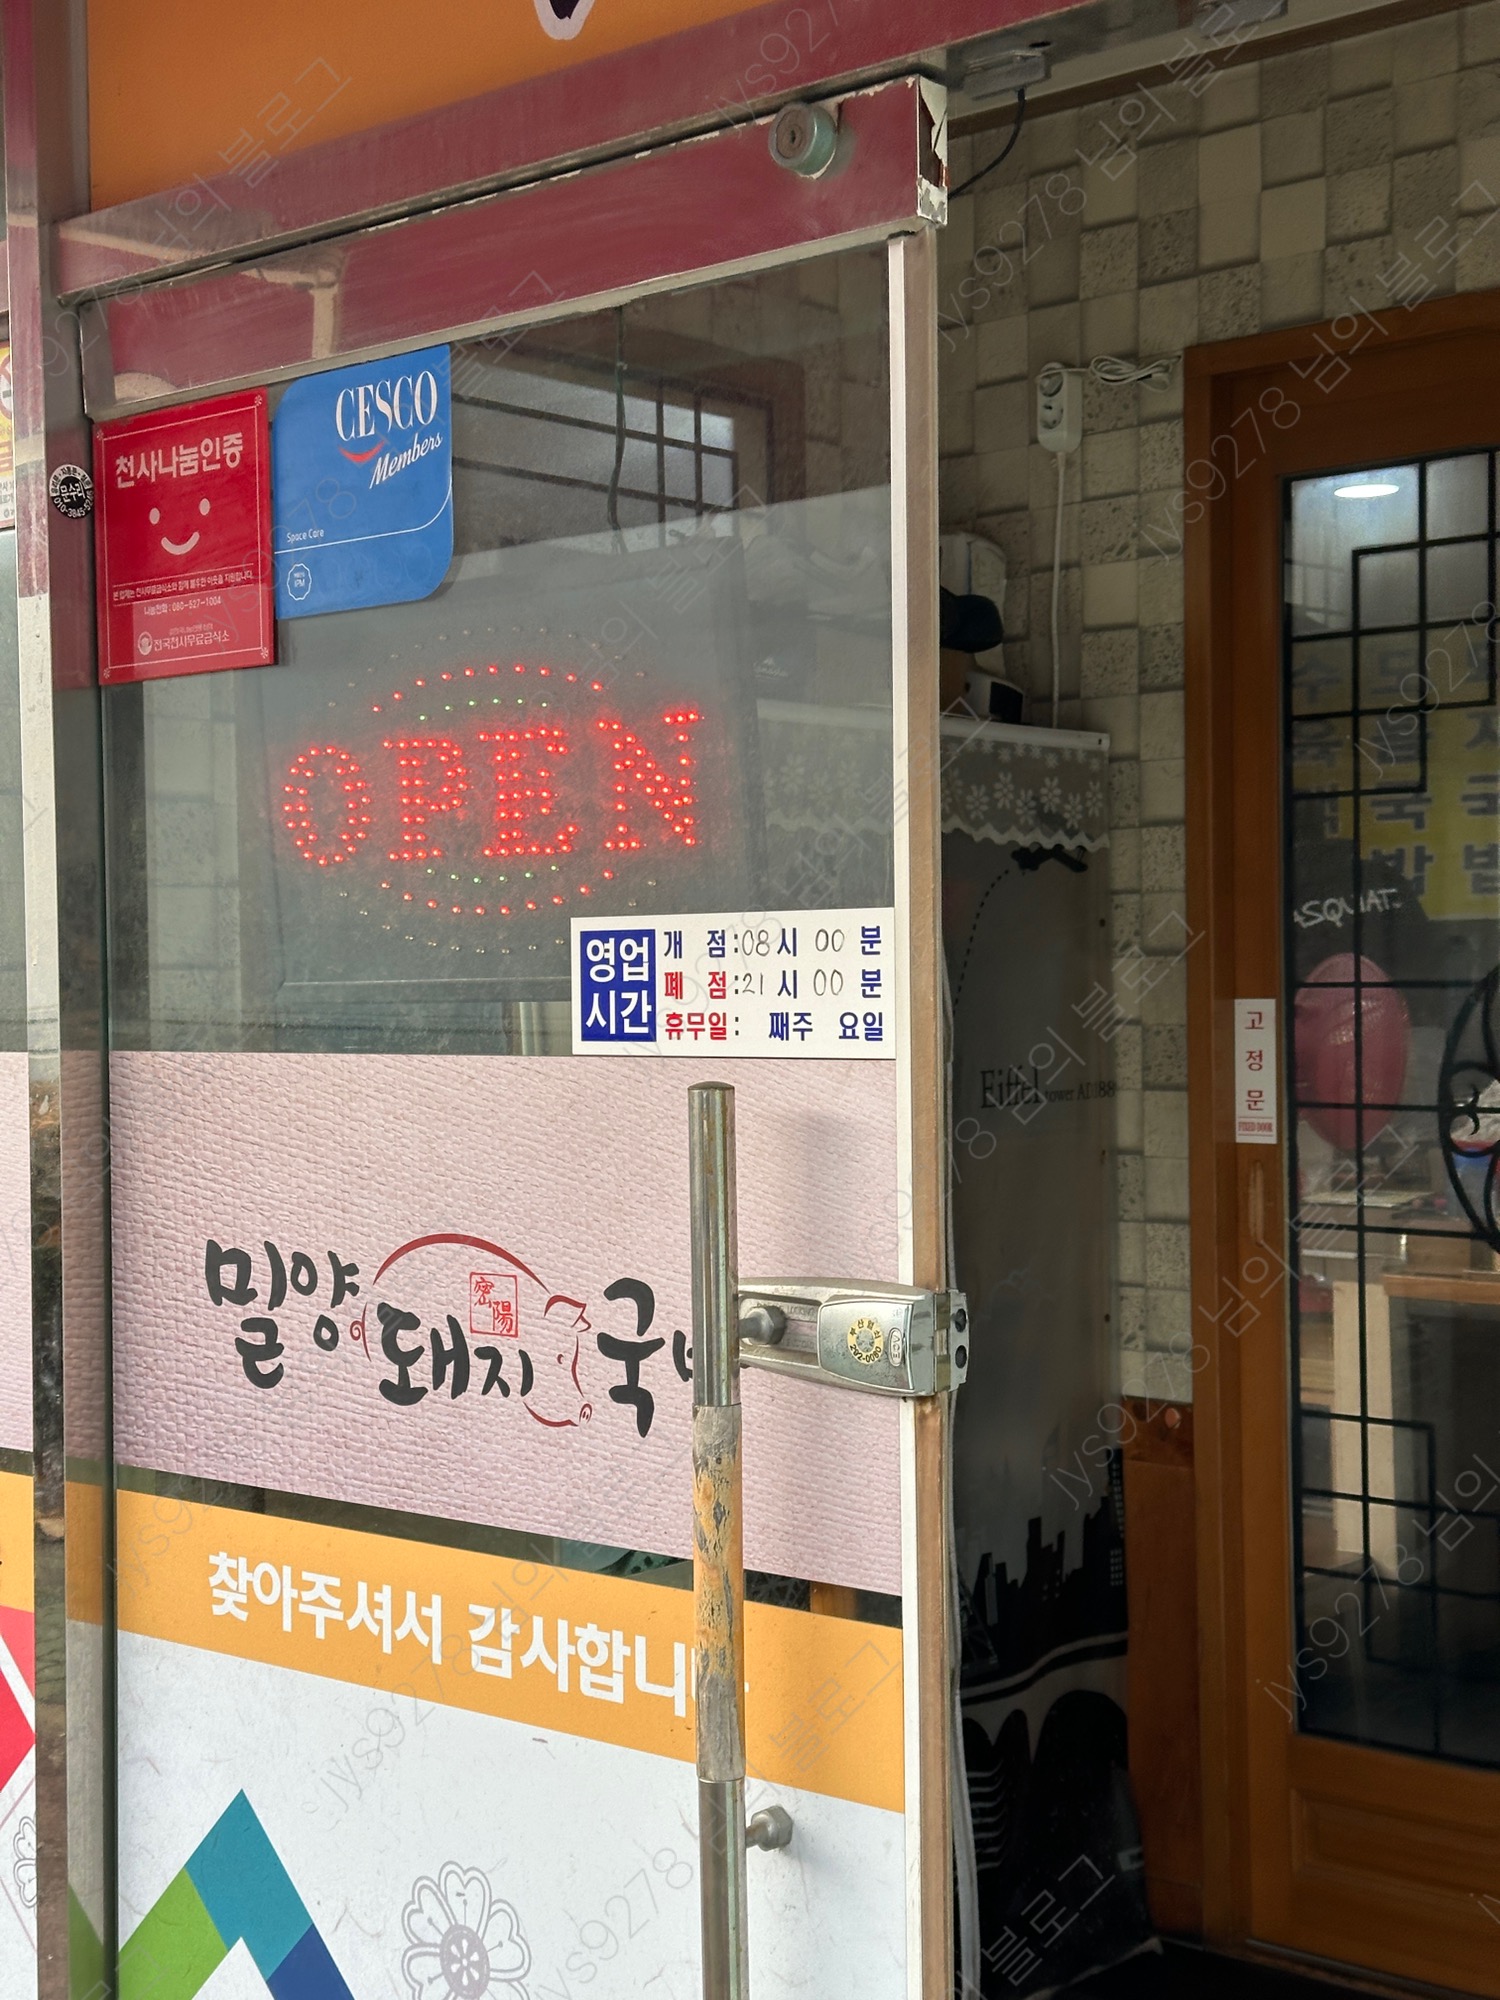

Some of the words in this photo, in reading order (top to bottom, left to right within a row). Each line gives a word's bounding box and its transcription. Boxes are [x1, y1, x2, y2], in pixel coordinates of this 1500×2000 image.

[335, 370, 438, 442] CESCO
[115, 432, 243, 489] 천사나눔인증
[369, 432, 443, 489] Members
[60, 481, 87, 504] 문수리
[286, 531, 307, 543] Space
[308, 528, 324, 540] Care
[154, 630, 230, 652] 전국천사무료급식소
[282, 711, 704, 867] OPEN
[586, 936, 650, 982] 영업
[664, 930, 683, 959] 개
[777, 927, 797, 957] 시
[814, 928, 845, 952] 00
[860, 925, 882, 955] 분
[664, 971, 683, 1000] 폐
[742, 972, 764, 995] 21
[777, 969, 798, 999] 시
[813, 968, 844, 996] 00
[860, 969, 882, 999] 분
[586, 989, 652, 1034] 시간
[769, 1011, 813, 1041] 째주
[838, 1011, 884, 1041] 요일
[1244, 1011, 1264, 1111] 고정문
[205, 1239, 359, 1389] 밀양
[376, 1302, 534, 1406] 돼지
[208, 1551, 442, 1665] 찾아주셔서
[468, 1603, 748, 1718] 감사합니
